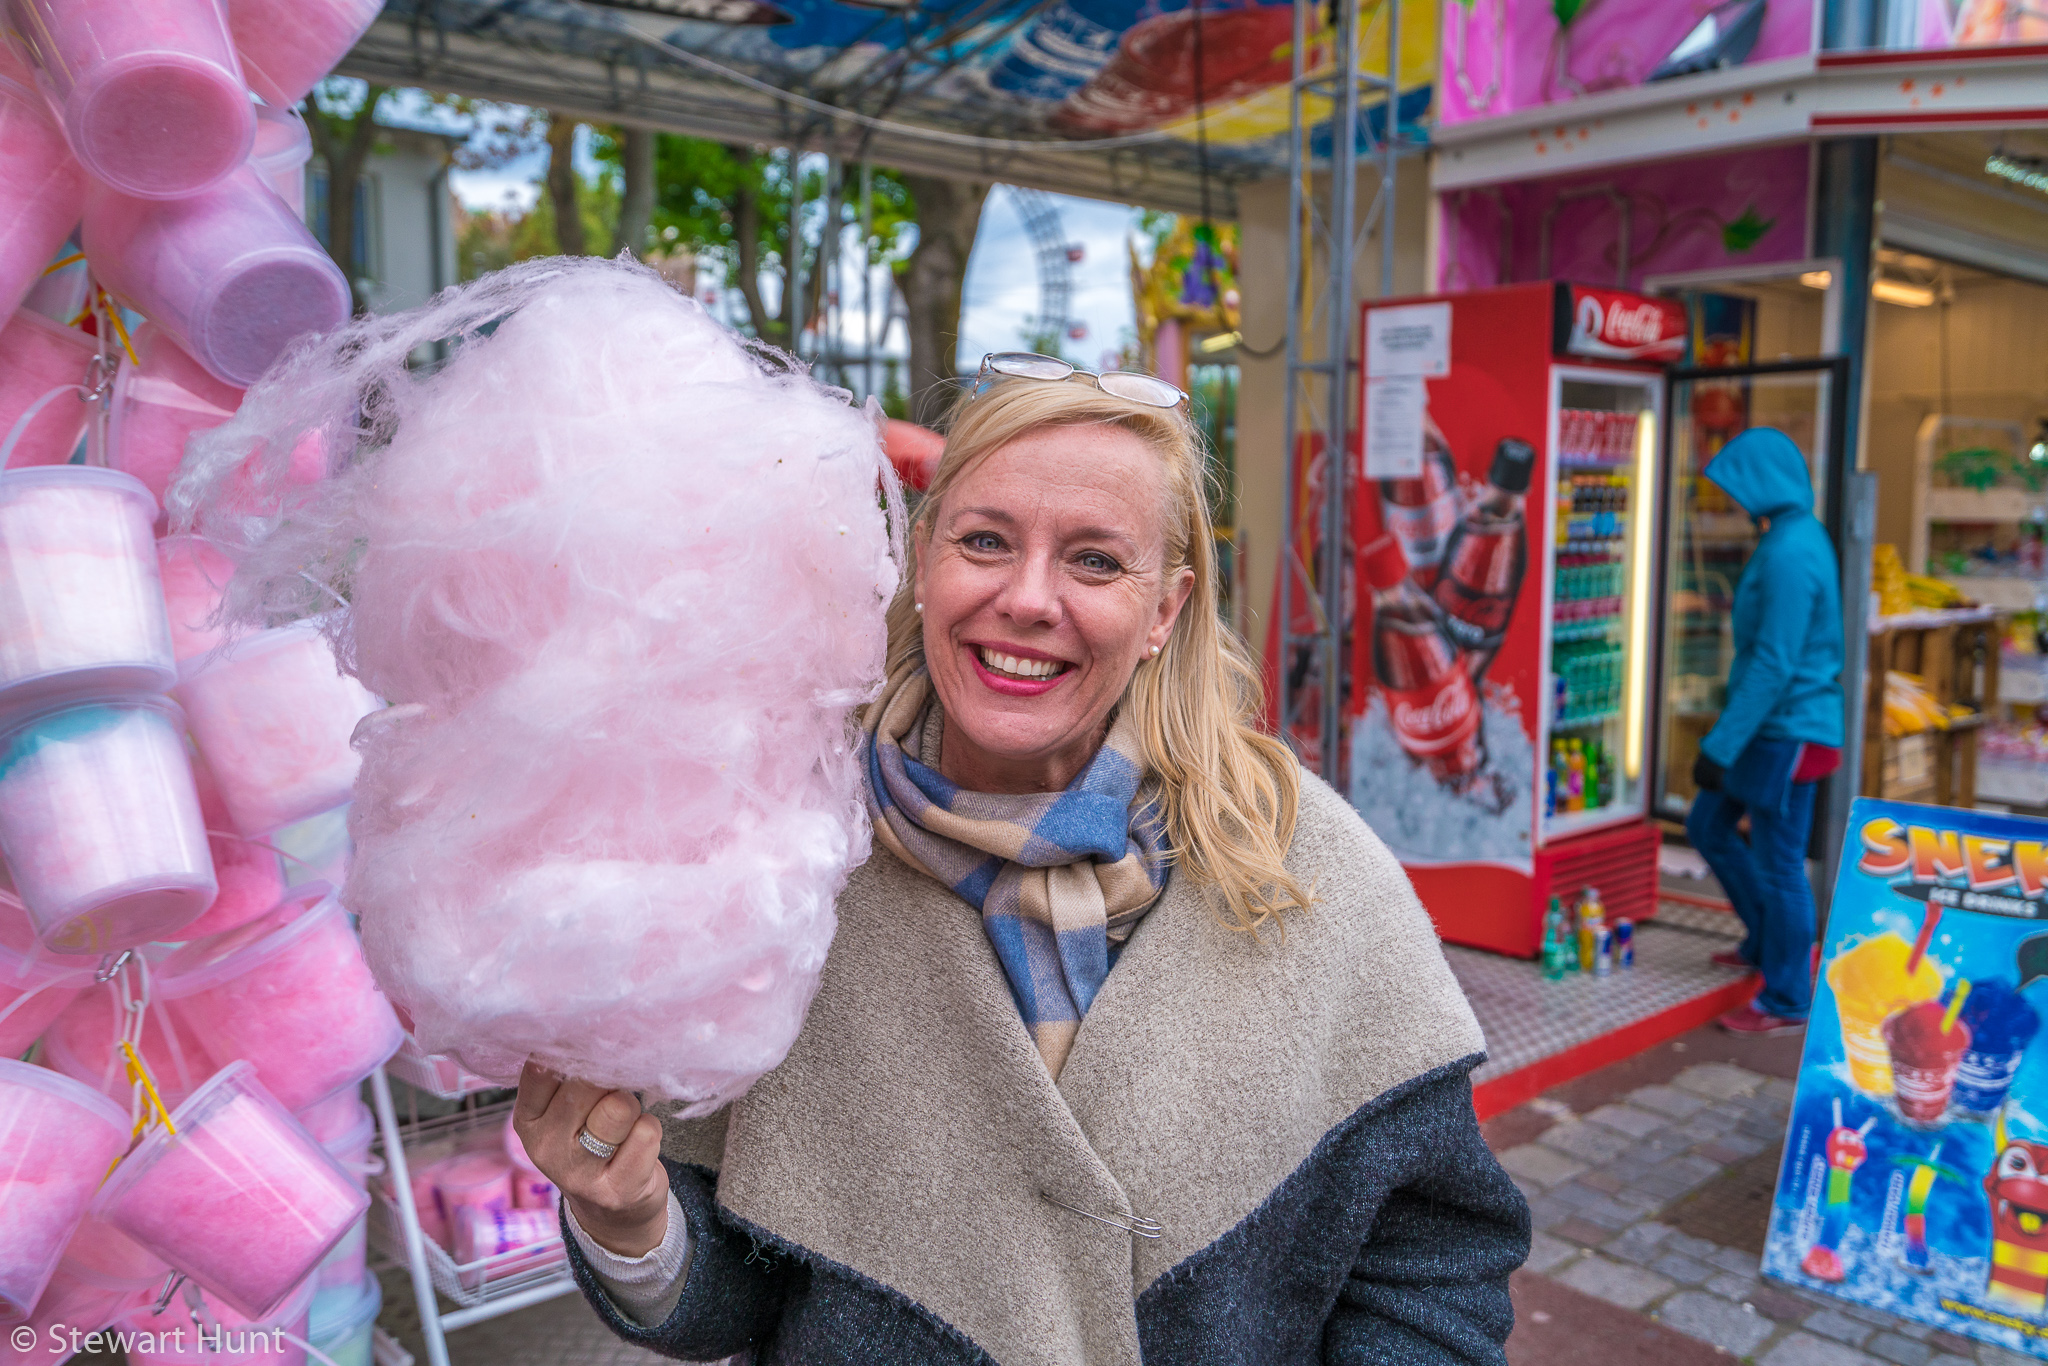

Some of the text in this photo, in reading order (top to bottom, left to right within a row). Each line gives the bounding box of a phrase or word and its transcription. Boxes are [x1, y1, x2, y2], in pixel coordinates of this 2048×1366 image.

[1605, 299, 1663, 344] Coca-Cola
[1394, 674, 1470, 734] Coca-Cola
[1928, 886, 2038, 918] ICE DRINKS
